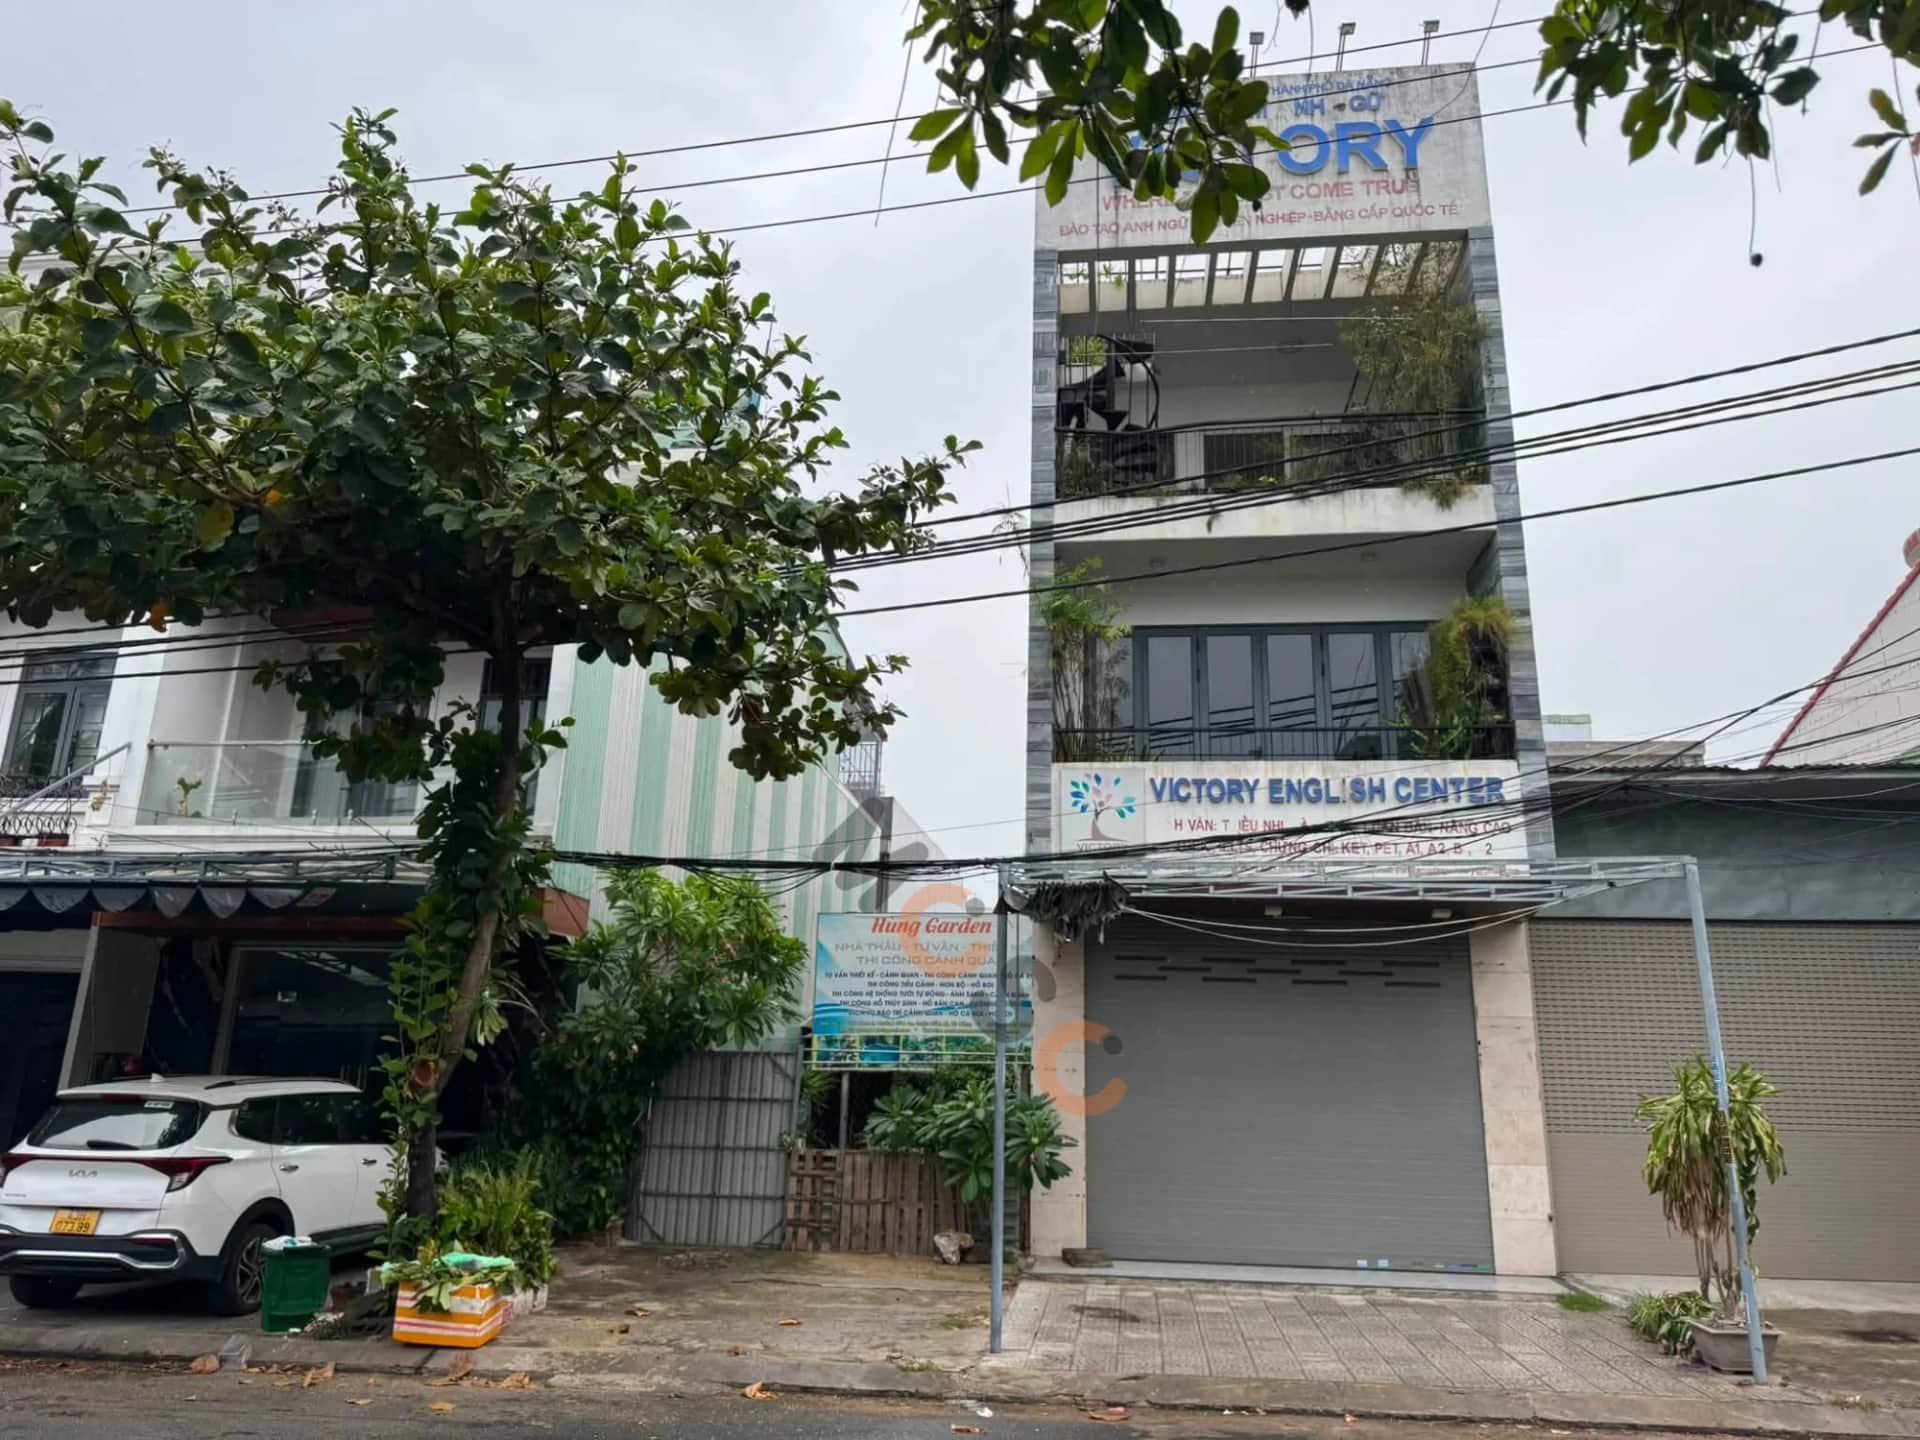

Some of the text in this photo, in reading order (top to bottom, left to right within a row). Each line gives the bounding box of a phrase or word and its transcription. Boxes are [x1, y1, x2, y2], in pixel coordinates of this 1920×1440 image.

[1290, 180, 1353, 199] COME
[1361, 178, 1418, 197] TRUE
[1123, 221, 1153, 234] ANH
[1149, 777, 1260, 804] VICTORY
[1394, 776, 1506, 804] CENTER
[925, 916, 993, 934] Garden
[967, 953, 997, 966] QUA
